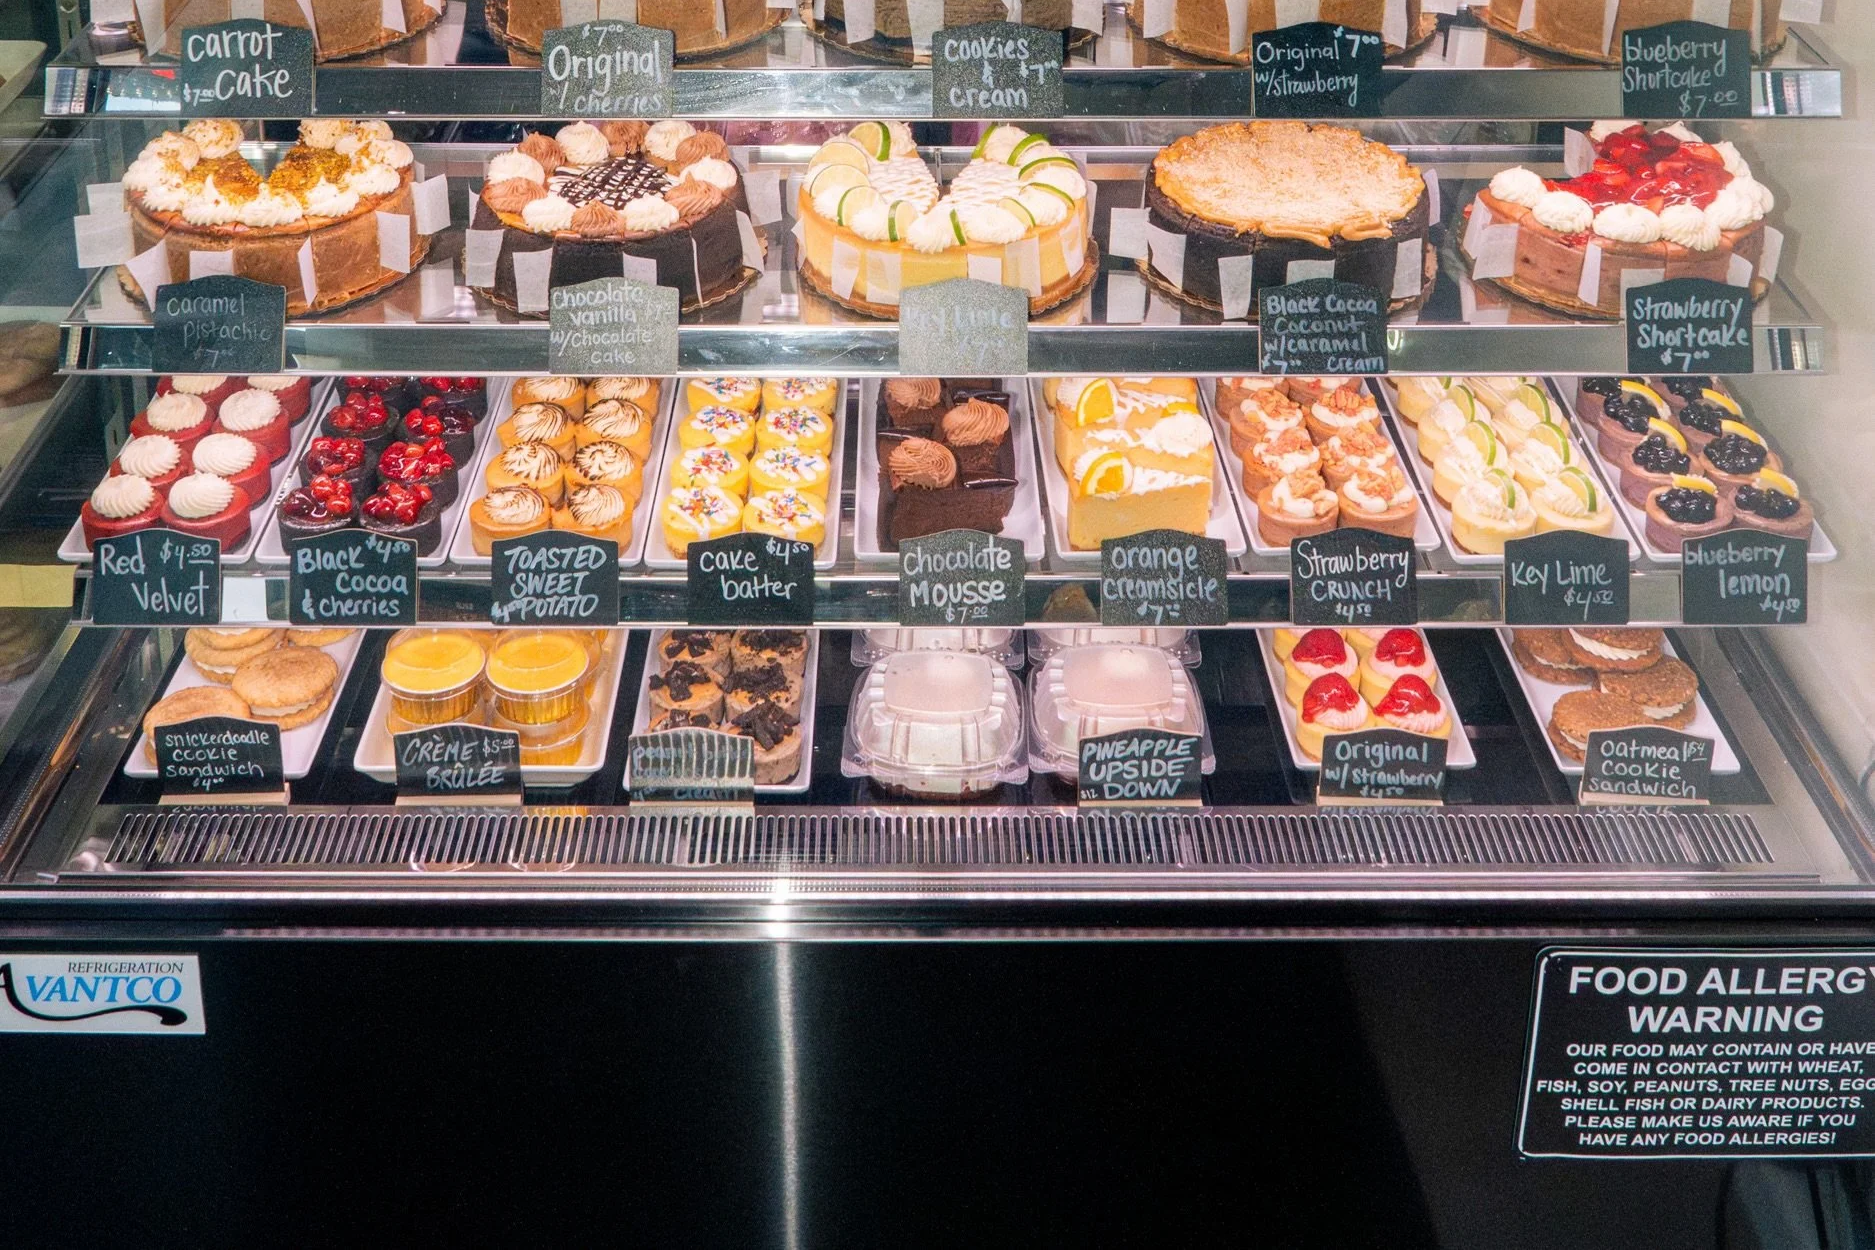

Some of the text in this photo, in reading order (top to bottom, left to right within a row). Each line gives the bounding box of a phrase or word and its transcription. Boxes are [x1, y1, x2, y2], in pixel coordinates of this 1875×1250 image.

[548, 40, 661, 97] Original
[1256, 39, 1340, 72] Original
[1625, 35, 1726, 77] blueberry
[1267, 294, 1378, 315] Black Cocoa
[1633, 295, 1743, 331] Strawberry
[1637, 323, 1750, 348] Shortcake
[100, 535, 146, 575] Red
[297, 545, 365, 574] Black
[504, 544, 607, 574] TOASTED
[1297, 539, 1409, 588] Strawberry
[1684, 541, 1786, 568] blueberry
[510, 571, 590, 599] SWEET
[720, 573, 798, 600] batter
[1311, 579, 1392, 602] CRUNCH
[1511, 560, 1612, 595] Key Lime
[1719, 568, 1791, 599] lemon
[131, 570, 209, 617] Velvet
[520, 594, 599, 621] POTATO
[165, 730, 270, 747] snickerdoodle
[1082, 737, 1197, 763] PINEAPPLE
[1600, 739, 1688, 762] Oatmeal
[1335, 740, 1428, 768] Original
[1089, 757, 1195, 782] UPSIDE
[1103, 778, 1181, 799] DOWN
[68, 962, 184, 973] REFRIGERATION
[1569, 966, 1875, 995] FOOD ALLERG
[1628, 1005, 1824, 1033] WARNING
[1566, 1042, 1875, 1057] OUR FOOD MAY CONTAIN OR HAVE
[1574, 1061, 1864, 1075] COME IN CONTACT WITH WHEAT,
[1536, 1080, 1582, 1096] FISH,
[1587, 1080, 1628, 1095] SOY,
[1633, 1080, 1722, 1094] PEANUTS,
[1729, 1079, 1777, 1092] TREE
[1781, 1079, 1834, 1093] NUTS,
[1561, 1096, 1865, 1111] SHELL FISH OR DAIRY PRODUCTS.
[1564, 1114, 1856, 1129] PLEASE MAKE US AWARE IF YOU
[1579, 1132, 1836, 1146] HAVE ANY FOOD ALLERGIES!
